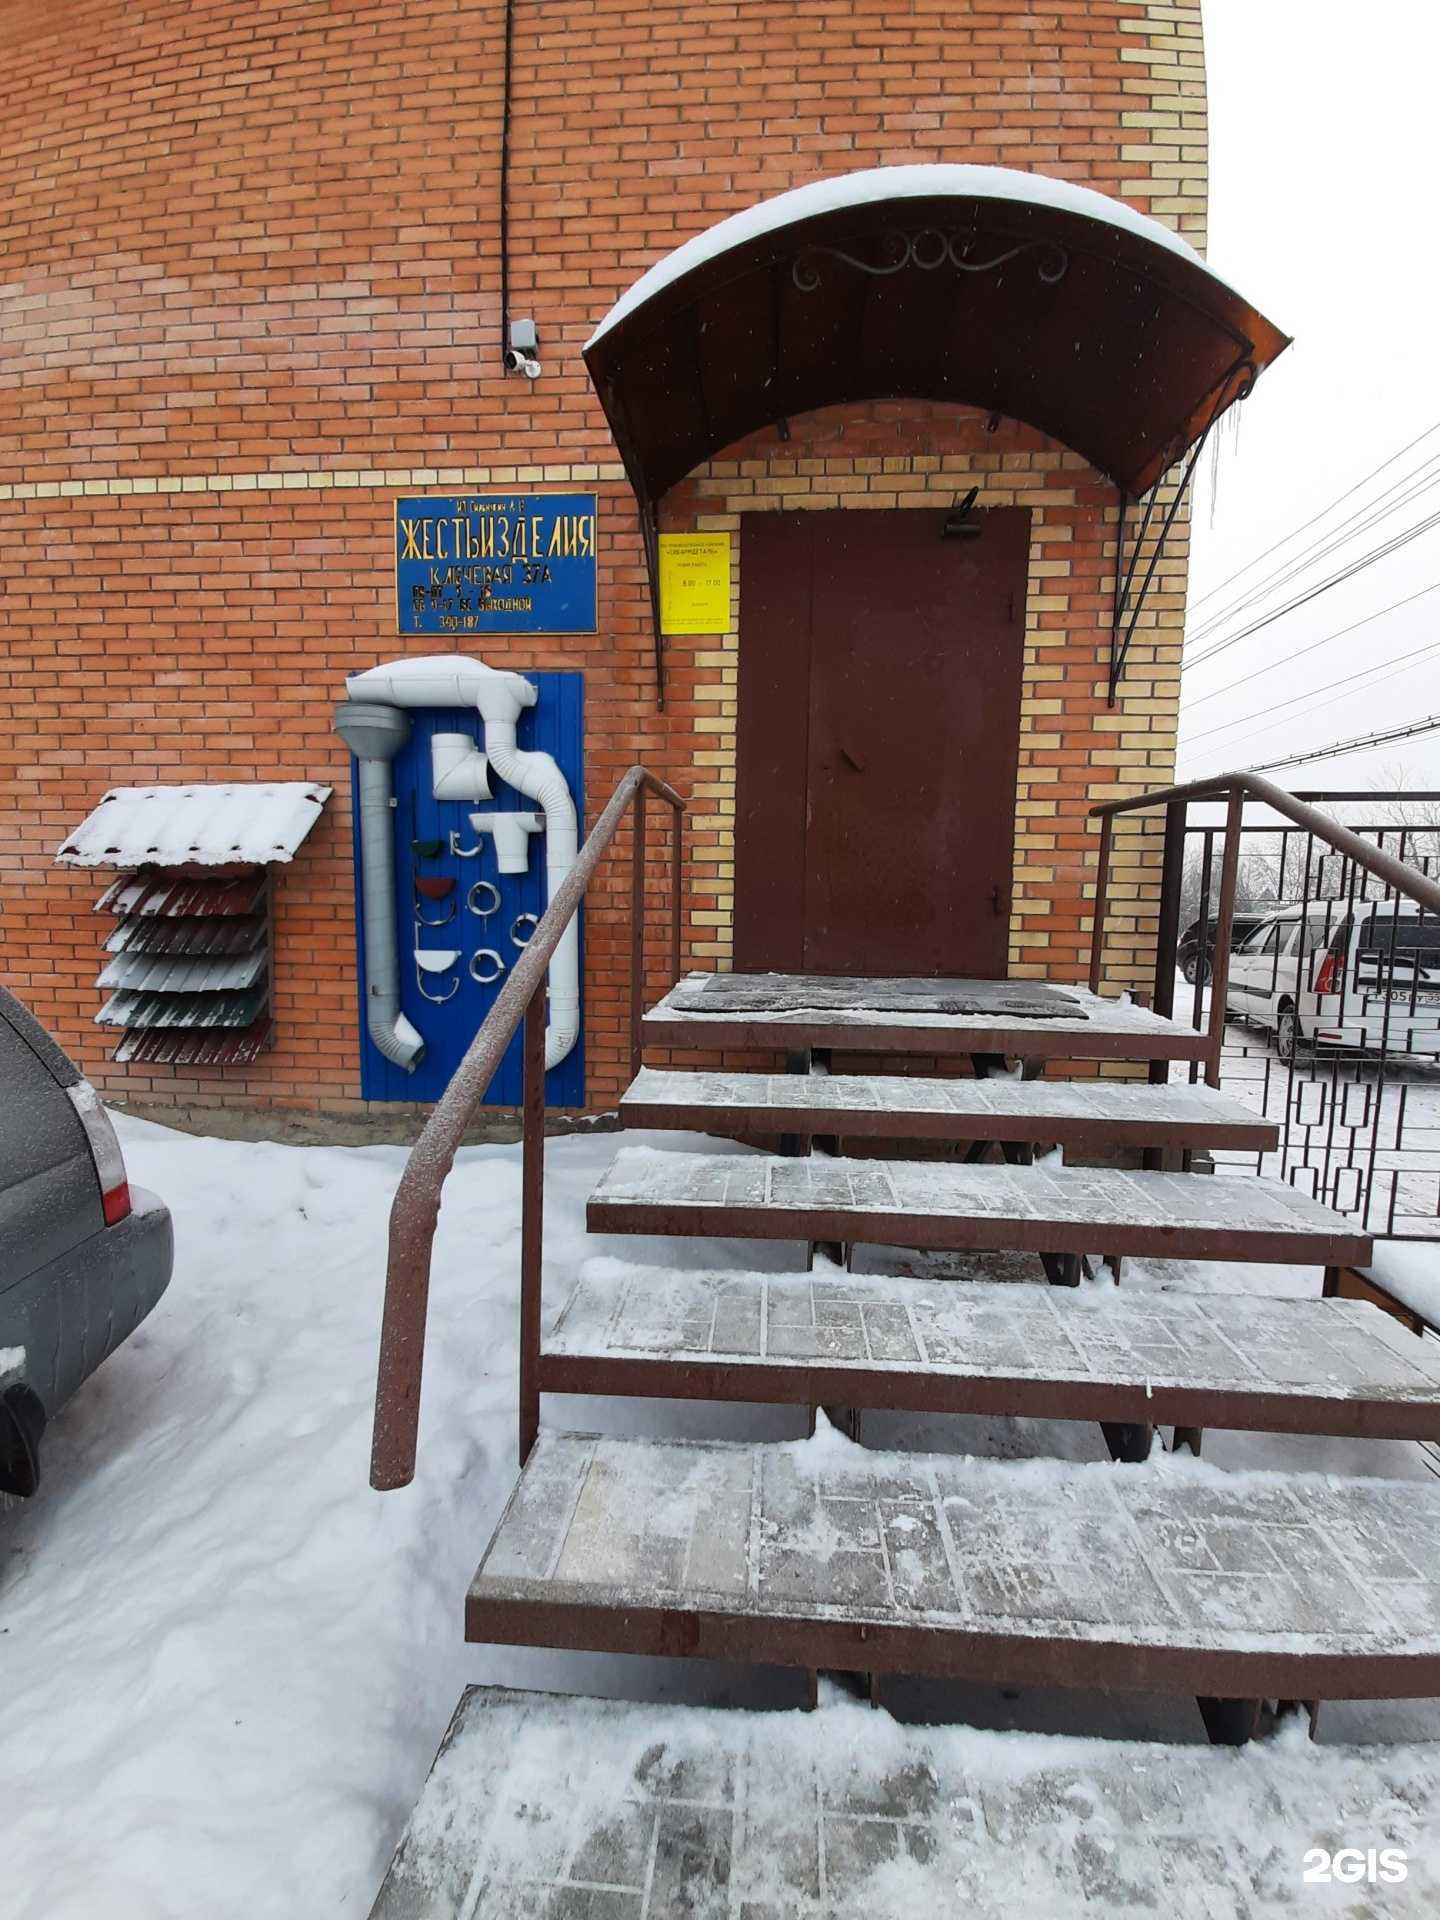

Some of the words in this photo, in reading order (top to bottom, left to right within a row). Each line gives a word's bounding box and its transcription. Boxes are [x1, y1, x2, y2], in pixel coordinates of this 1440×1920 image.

[400, 514, 596, 565] ЖЕСТЬИЗДЕЛИЯ
[429, 565, 513, 586] КЛЮЧЕВАЯ
[478, 596, 532, 613] ВЫХОДНОЙ
